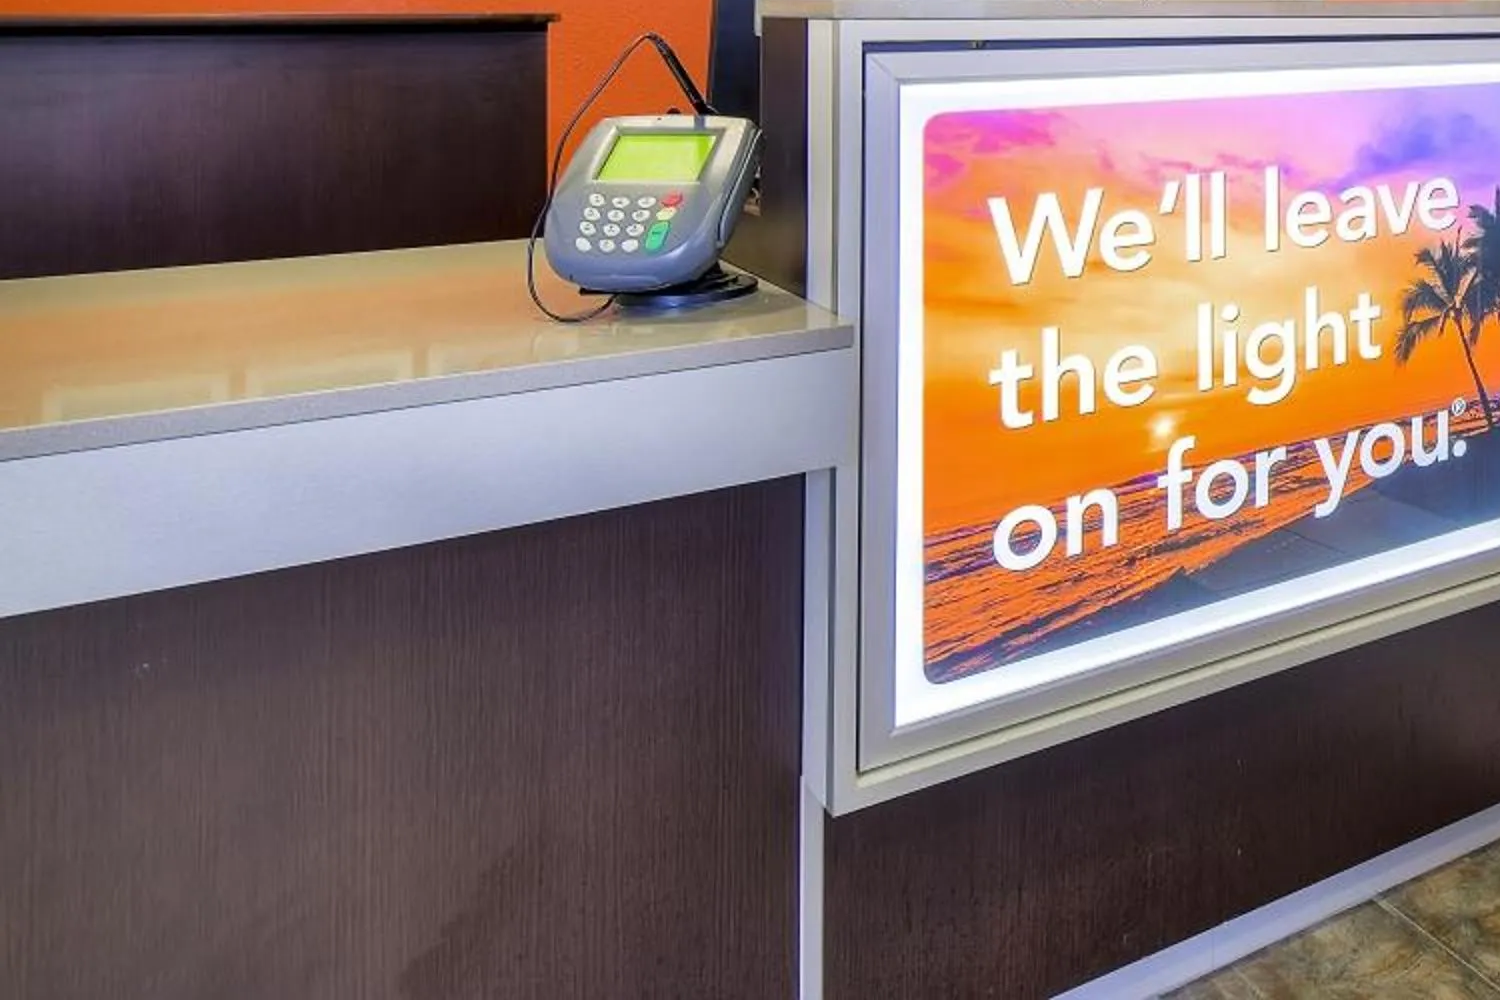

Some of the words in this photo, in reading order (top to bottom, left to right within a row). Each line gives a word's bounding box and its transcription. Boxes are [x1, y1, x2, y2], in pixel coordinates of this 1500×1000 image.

[988, 171, 1225, 286] We'll
[1265, 165, 1460, 252] leave
[988, 326, 1158, 429] the
[1198, 285, 1382, 405] light
[993, 487, 1119, 571] on
[1157, 436, 1286, 531] for
